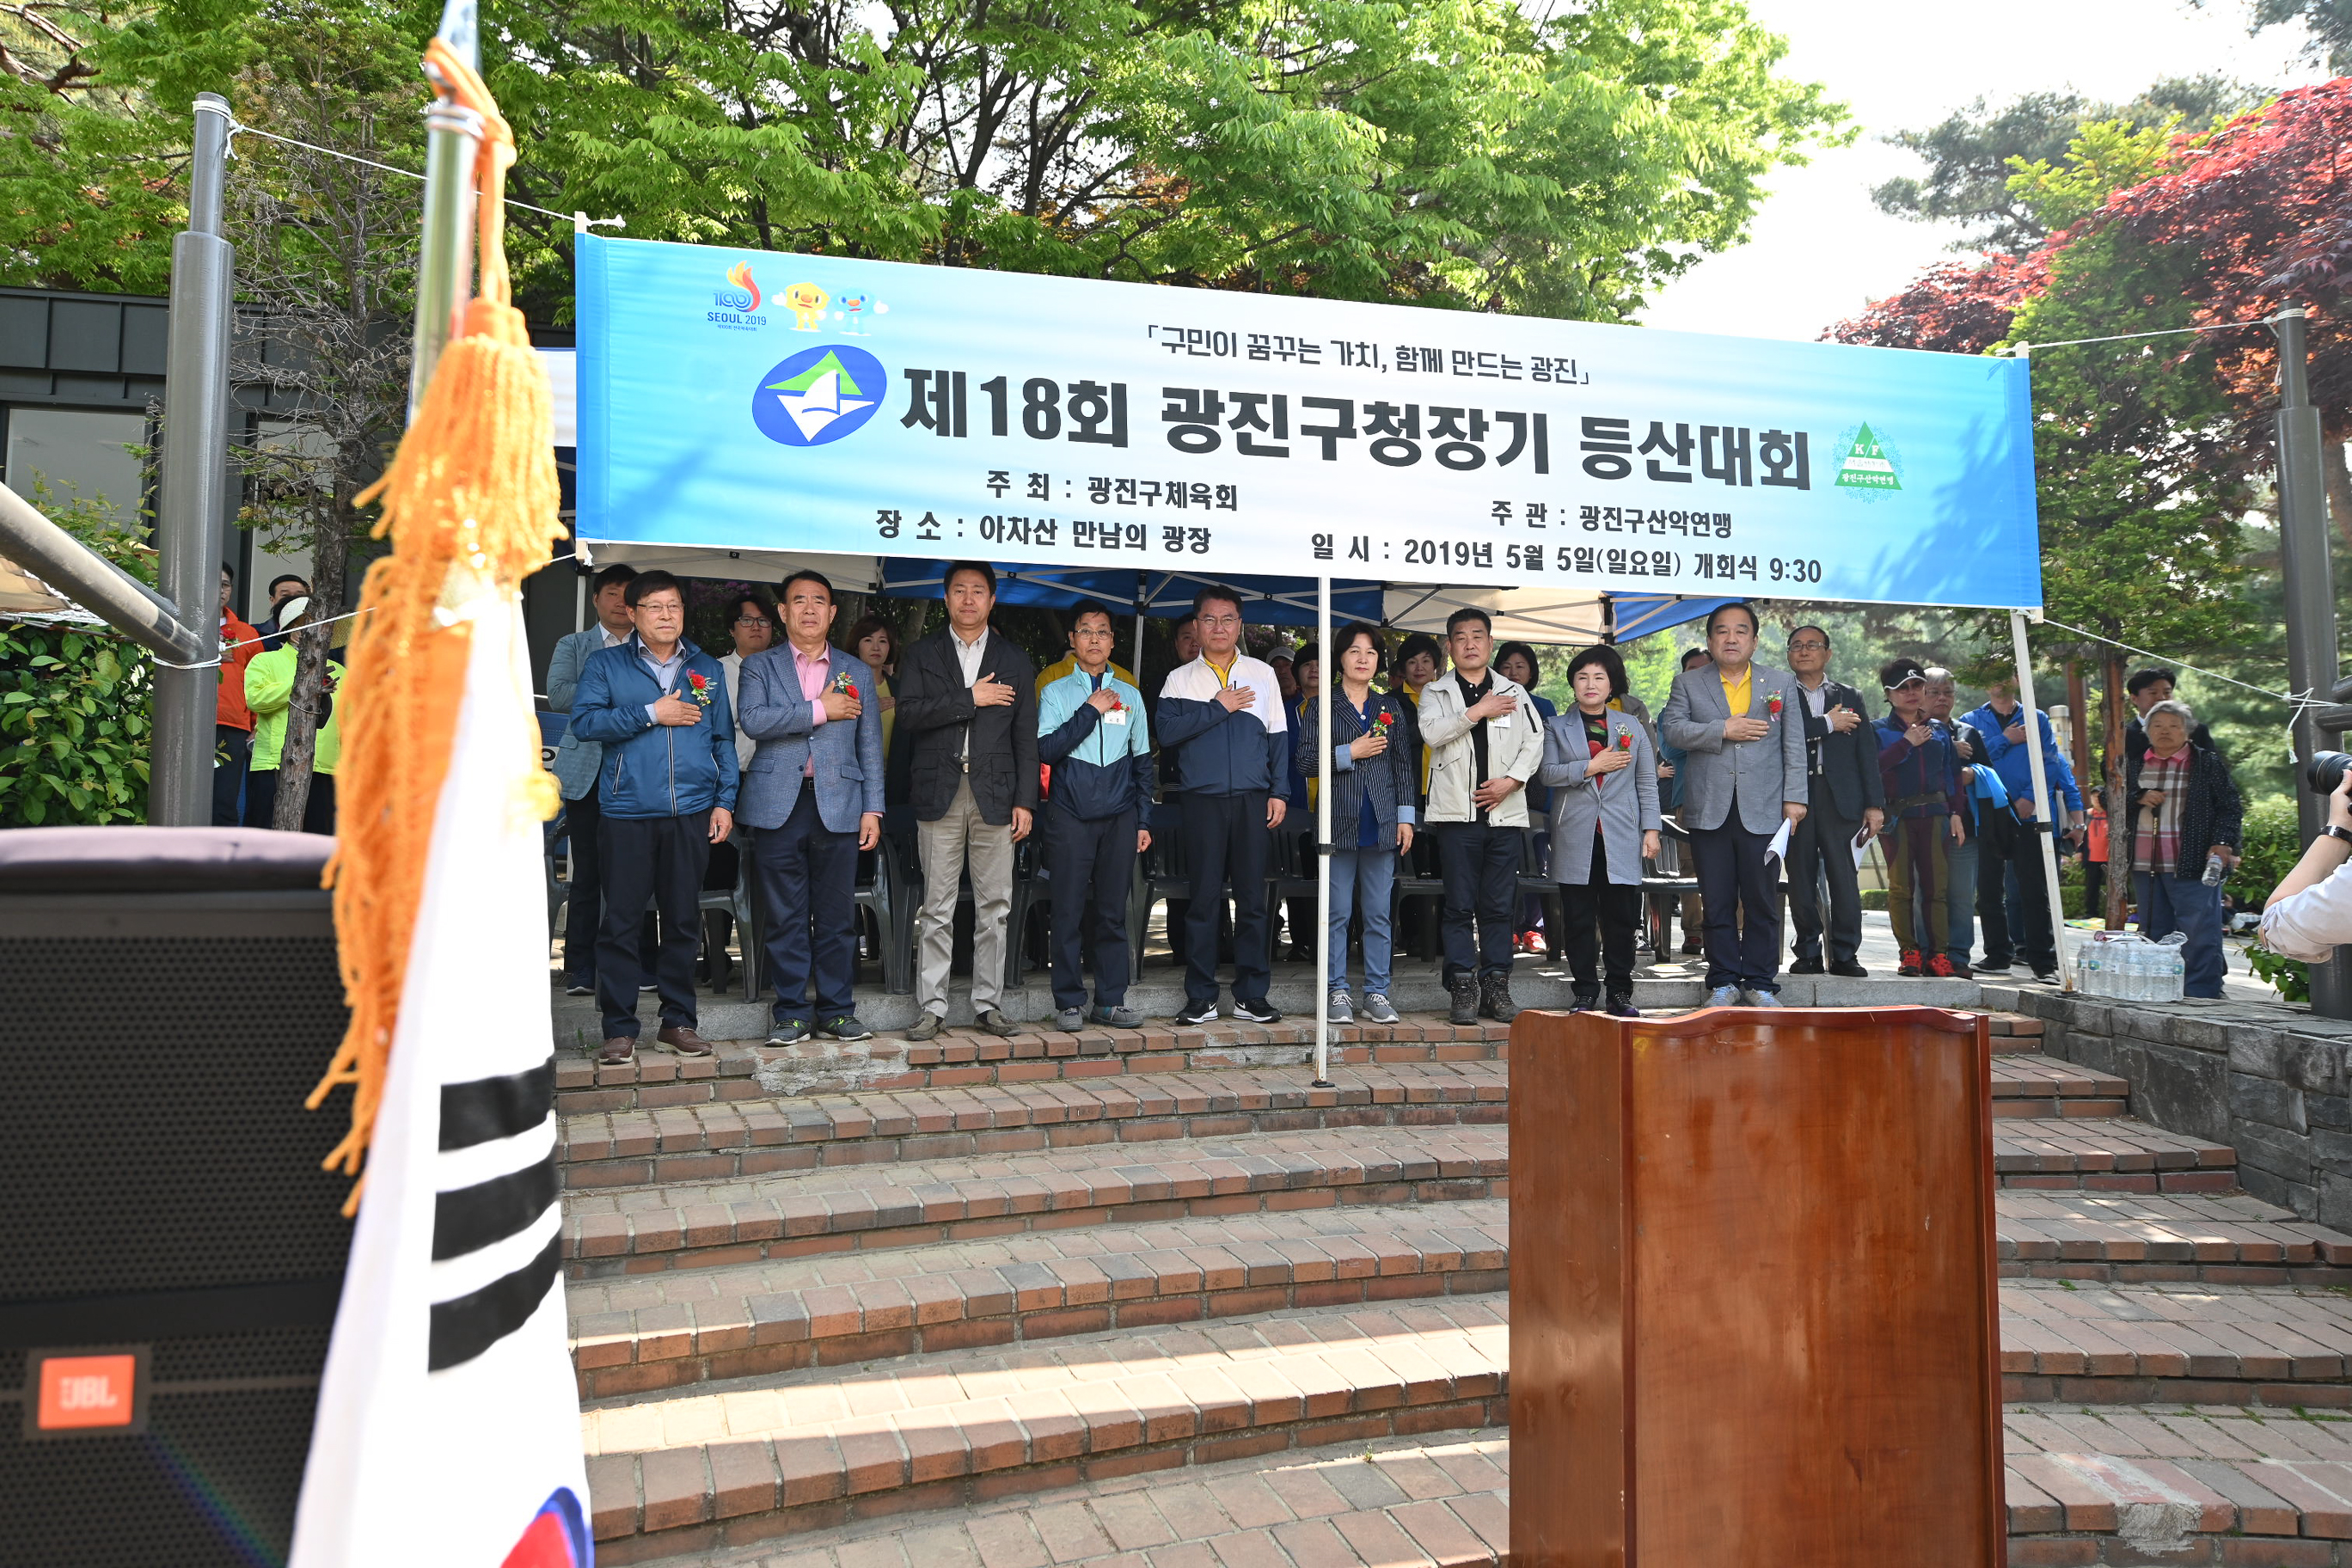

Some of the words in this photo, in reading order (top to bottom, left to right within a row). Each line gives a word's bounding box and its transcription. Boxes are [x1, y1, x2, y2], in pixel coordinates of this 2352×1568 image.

[707, 312, 742, 324] SEOUL
[745, 316, 767, 326] 2019
[1148, 324, 1236, 357] 「구민이
[1246, 333, 1321, 364] 꿈꾸는
[1330, 340, 1387, 373] 가치,
[1395, 345, 1442, 372] 함께
[1451, 350, 1522, 380] 만드는
[1531, 356, 1588, 384] 광진」
[899, 368, 1128, 448] 제18회
[1161, 387, 1548, 474] 광진구청장기
[1580, 416, 1810, 490] 등산대회
[1854, 443, 1865, 455] K
[1871, 444, 1880, 456] F
[1087, 476, 1236, 511] 광진구체육회
[1841, 473, 1894, 486] 광진구산악연맹
[979, 515, 1057, 545] 아차산
[1073, 520, 1146, 550] 만남의
[1162, 525, 1211, 554] 광장
[1579, 505, 1730, 538] 광진구산악연맹
[1404, 538, 1492, 567] 2019년
[1506, 544, 1543, 571] 5월
[1557, 547, 1680, 576] 5일(일요일)
[1694, 553, 1756, 580] 개회식
[1769, 557, 1821, 583] 9:30
[59, 1376, 118, 1410] JBL
